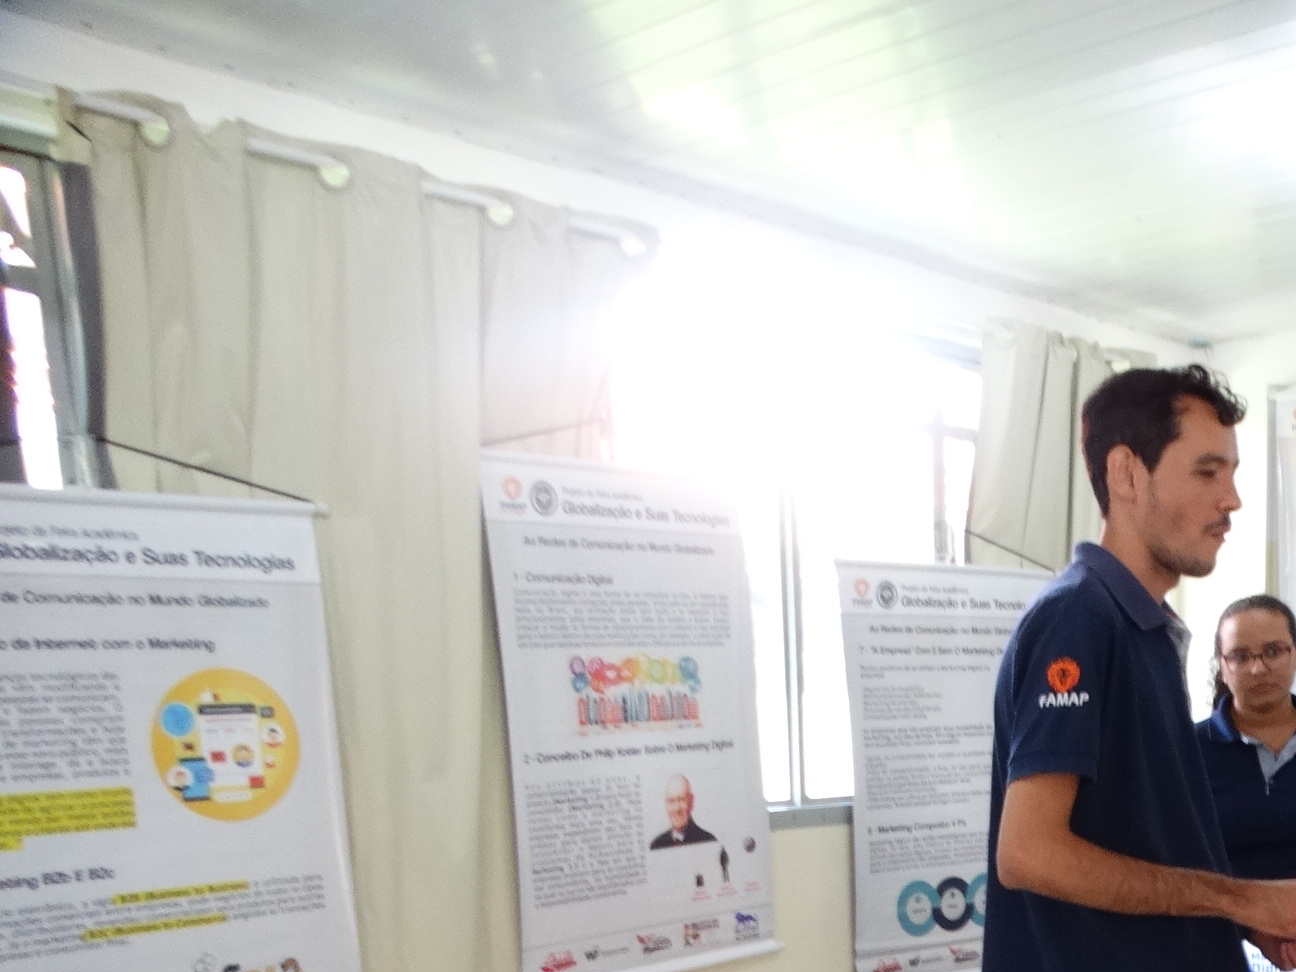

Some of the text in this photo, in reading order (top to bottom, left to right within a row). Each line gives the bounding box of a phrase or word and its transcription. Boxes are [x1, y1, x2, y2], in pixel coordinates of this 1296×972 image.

[562, 500, 633, 520] Globalização
[124, 550, 136, 564] e
[141, 547, 189, 566] Suas
[190, 549, 295, 574] Tecnologias
[901, 596, 958, 610] Globalização
[969, 598, 992, 610] Suas
[993, 598, 1026, 611] Tecnolo
[147, 637, 216, 653] Marketing
[1038, 690, 1090, 708] FAMAP
